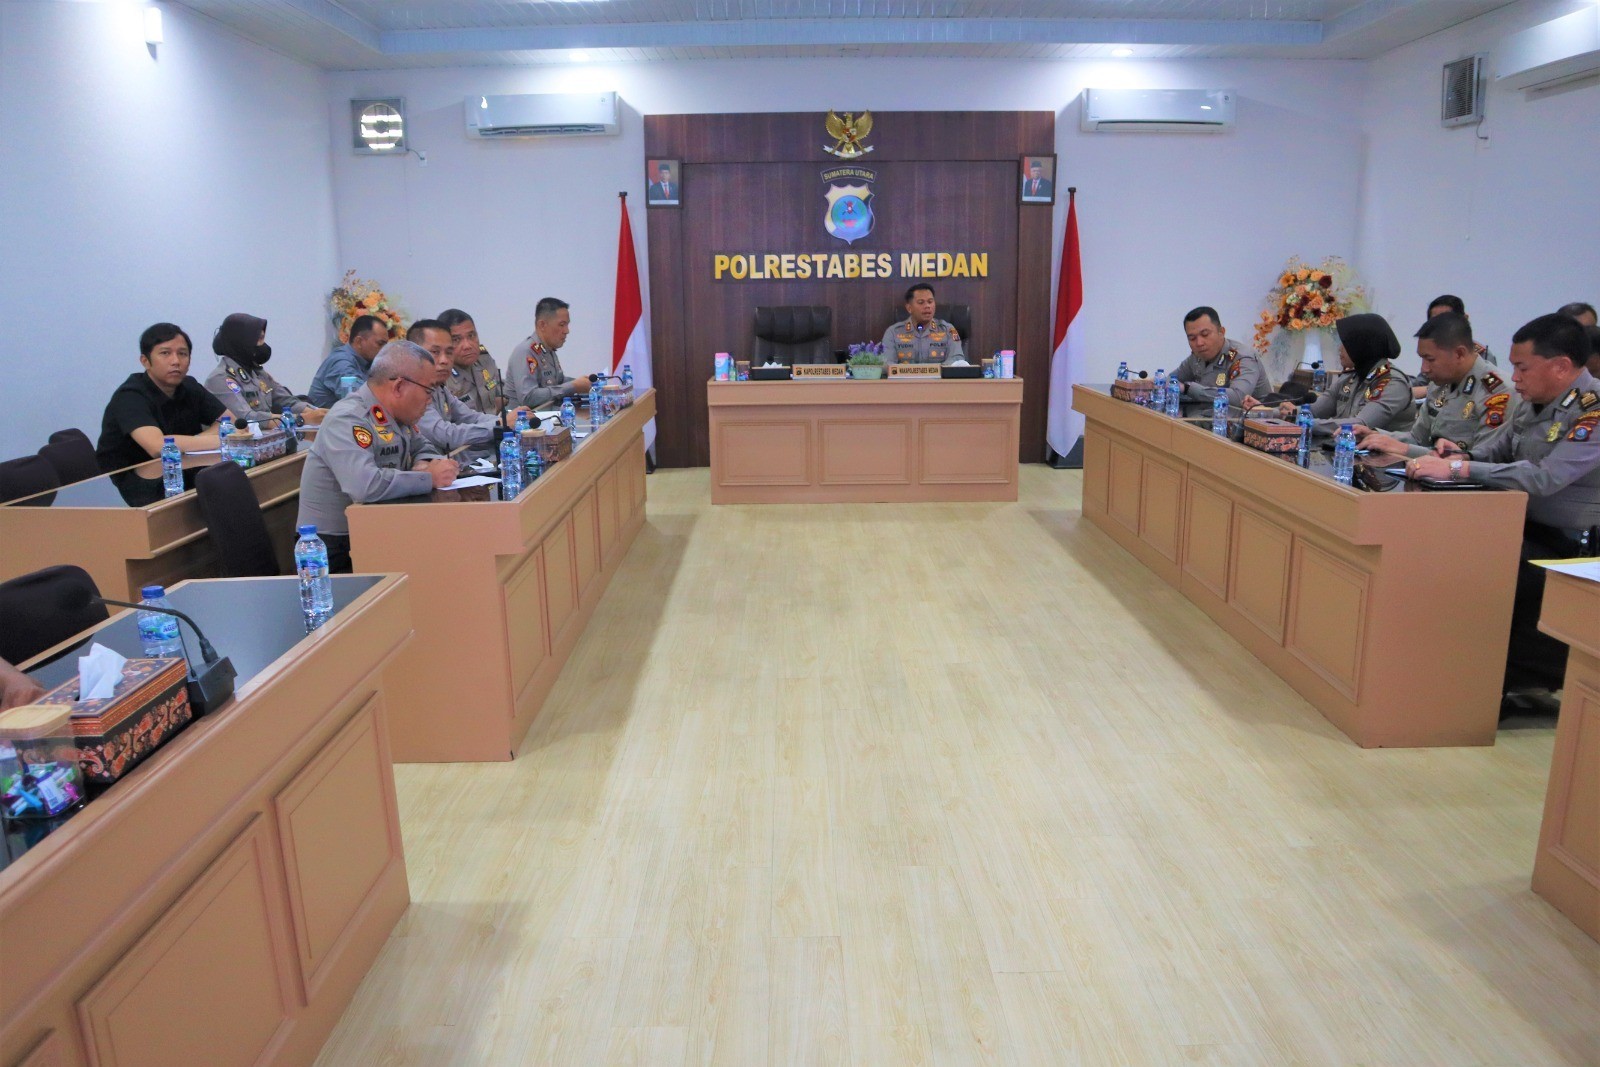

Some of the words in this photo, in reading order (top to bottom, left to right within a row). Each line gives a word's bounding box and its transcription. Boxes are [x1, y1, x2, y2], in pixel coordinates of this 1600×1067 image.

[823, 168, 855, 180] SUMATERA
[855, 169, 874, 180] UTARA
[715, 253, 892, 280] POLRESTABES
[901, 253, 988, 278] MEDAN
[832, 367, 844, 375] MEDAN
[380, 445, 399, 457] ADAM
